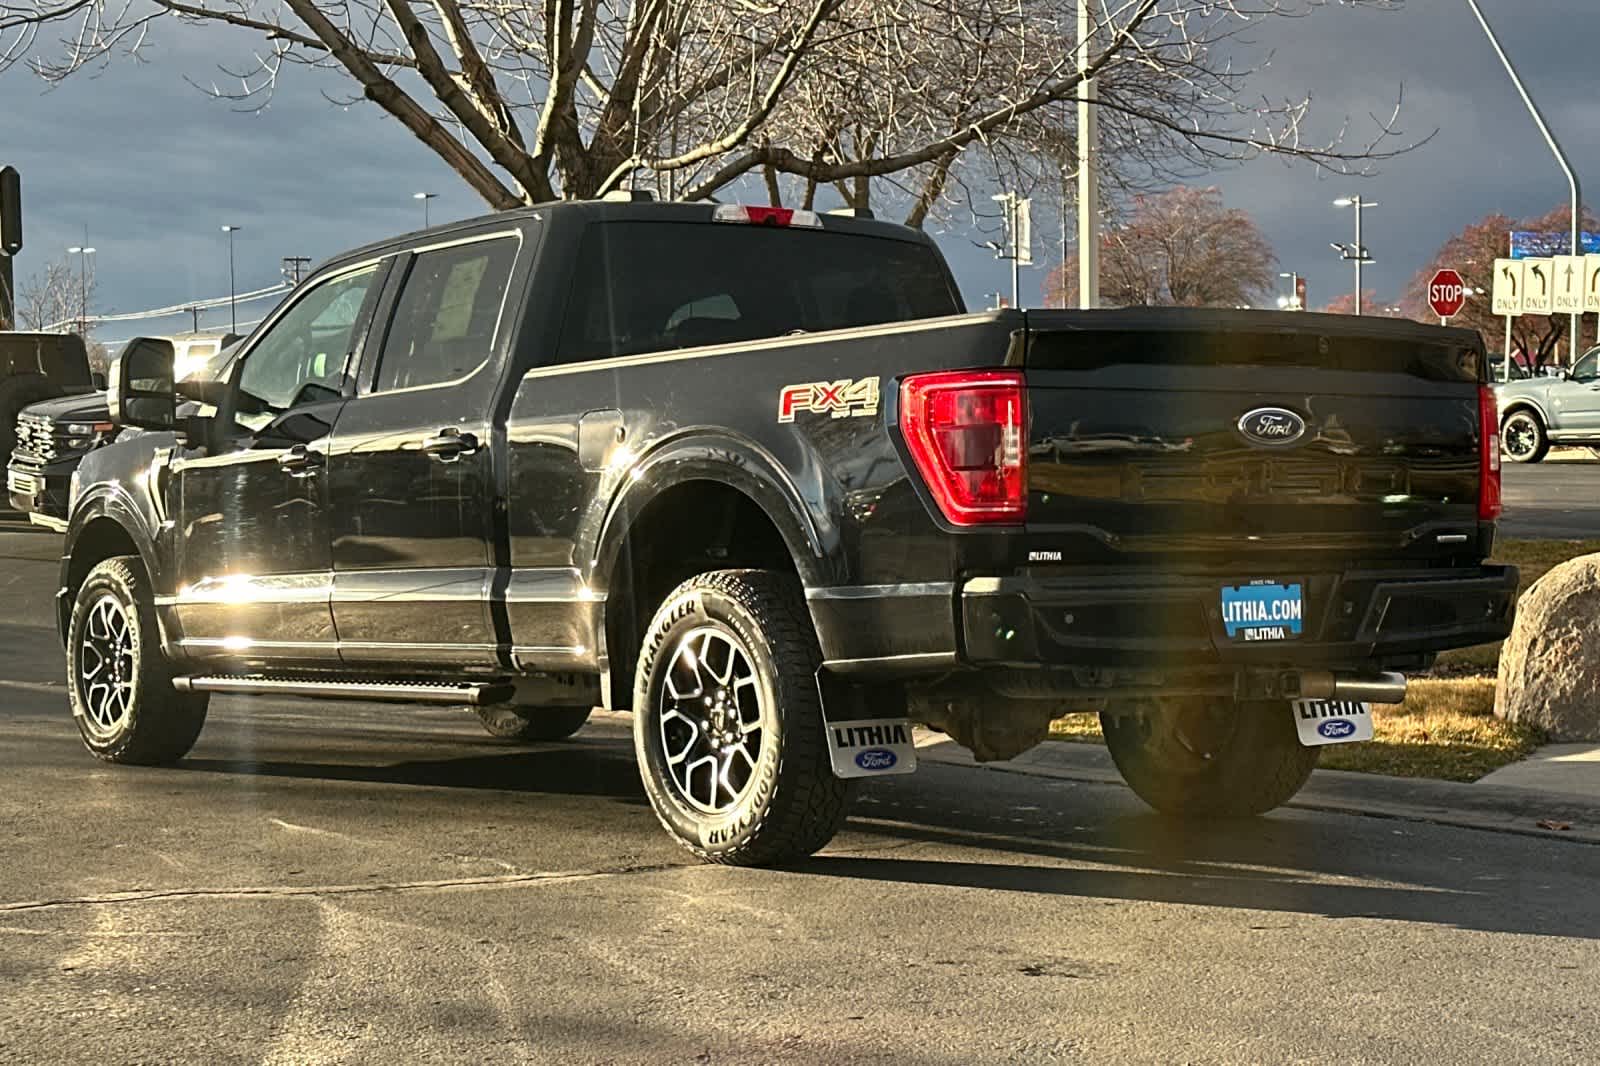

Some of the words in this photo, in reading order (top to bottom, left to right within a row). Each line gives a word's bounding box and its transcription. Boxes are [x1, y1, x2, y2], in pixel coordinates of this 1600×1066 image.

[1431, 284, 1462, 302] STOP
[1496, 298, 1518, 310] ONLY
[1526, 297, 1547, 309] ONLY
[1556, 296, 1578, 308] ONLY
[1587, 295, 1600, 307] ON
[778, 376, 880, 423] FX4
[1256, 415, 1292, 436] Ford
[1036, 551, 1062, 560] LITHIA
[1221, 599, 1302, 622] LITHIA.COM
[1254, 626, 1285, 640] LITHIA
[1299, 701, 1364, 719] LITHIA
[1323, 722, 1350, 736] Ford
[834, 725, 907, 748] LITHIA
[861, 752, 892, 767] Ford
